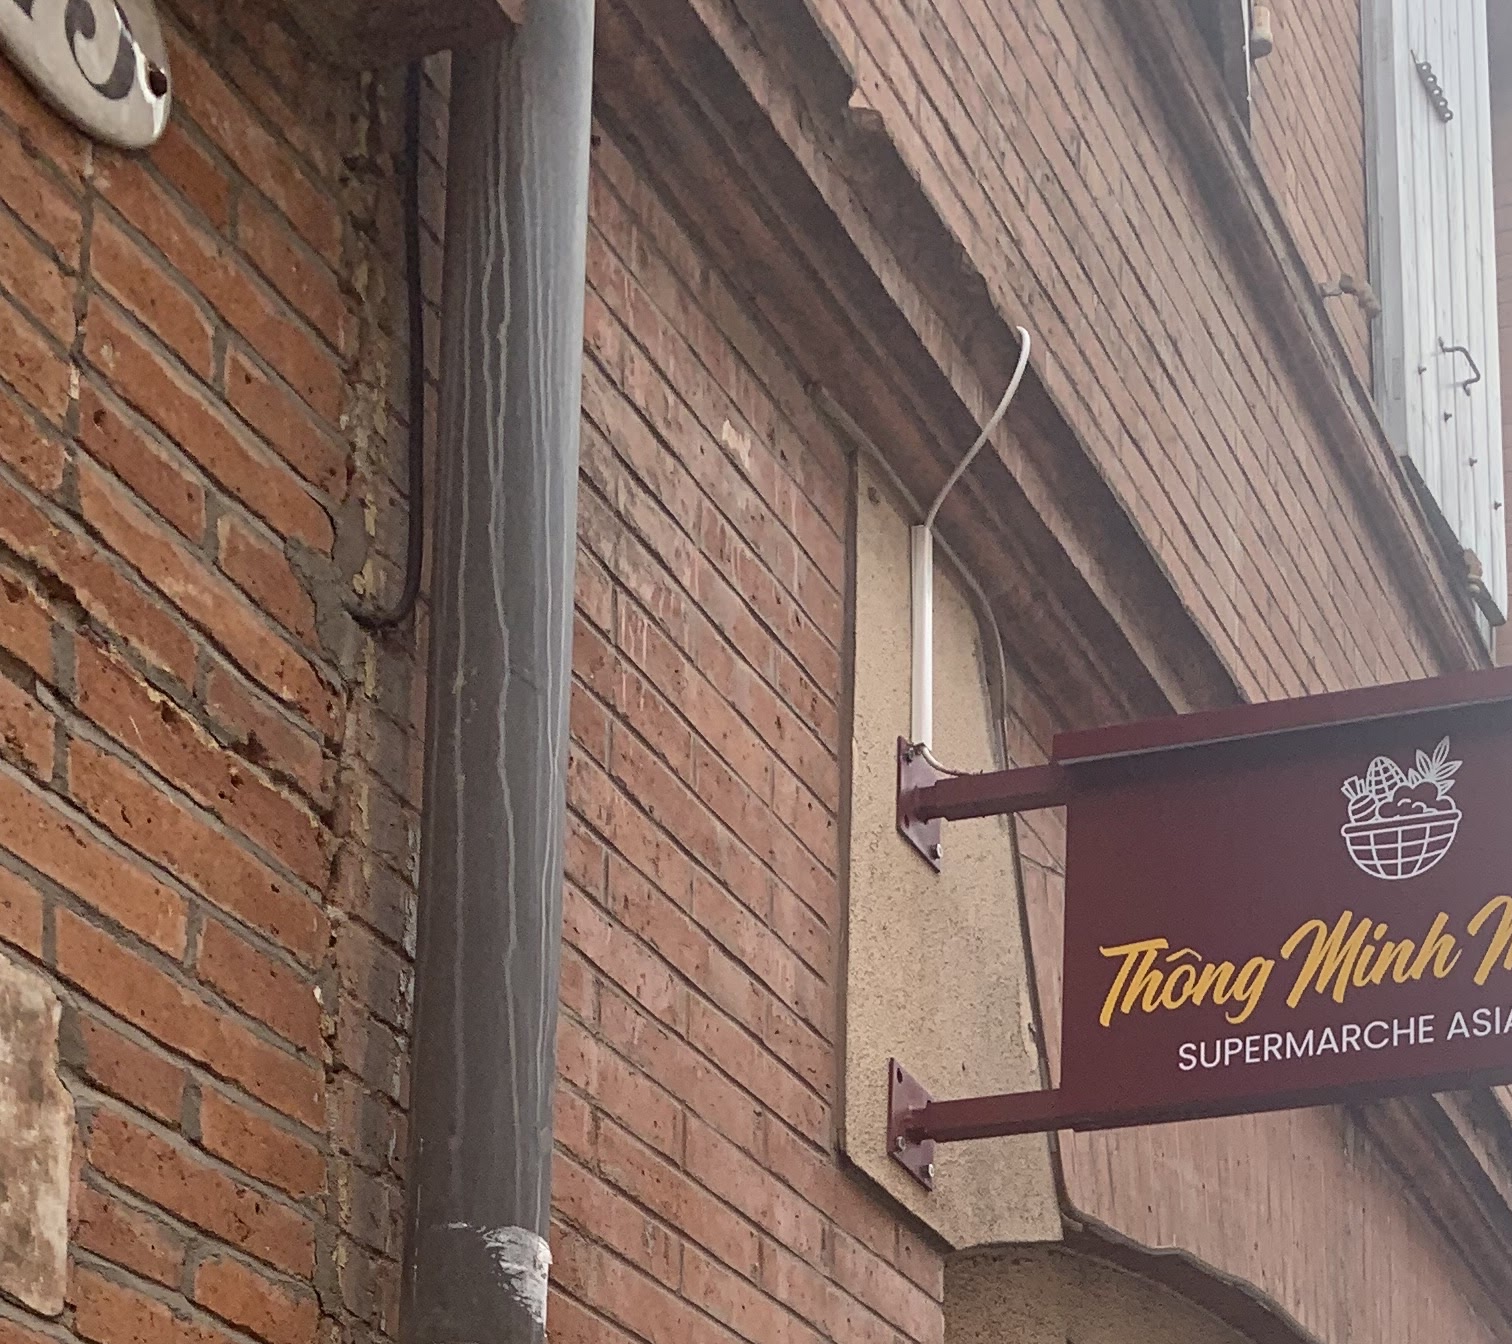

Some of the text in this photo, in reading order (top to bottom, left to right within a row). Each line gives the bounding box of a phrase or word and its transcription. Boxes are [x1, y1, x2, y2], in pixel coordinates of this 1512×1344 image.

[1098, 938, 1276, 1026] Thông
[1280, 910, 1463, 1009] Minh
[1177, 1013, 1435, 1072] SUPERMARCHE
